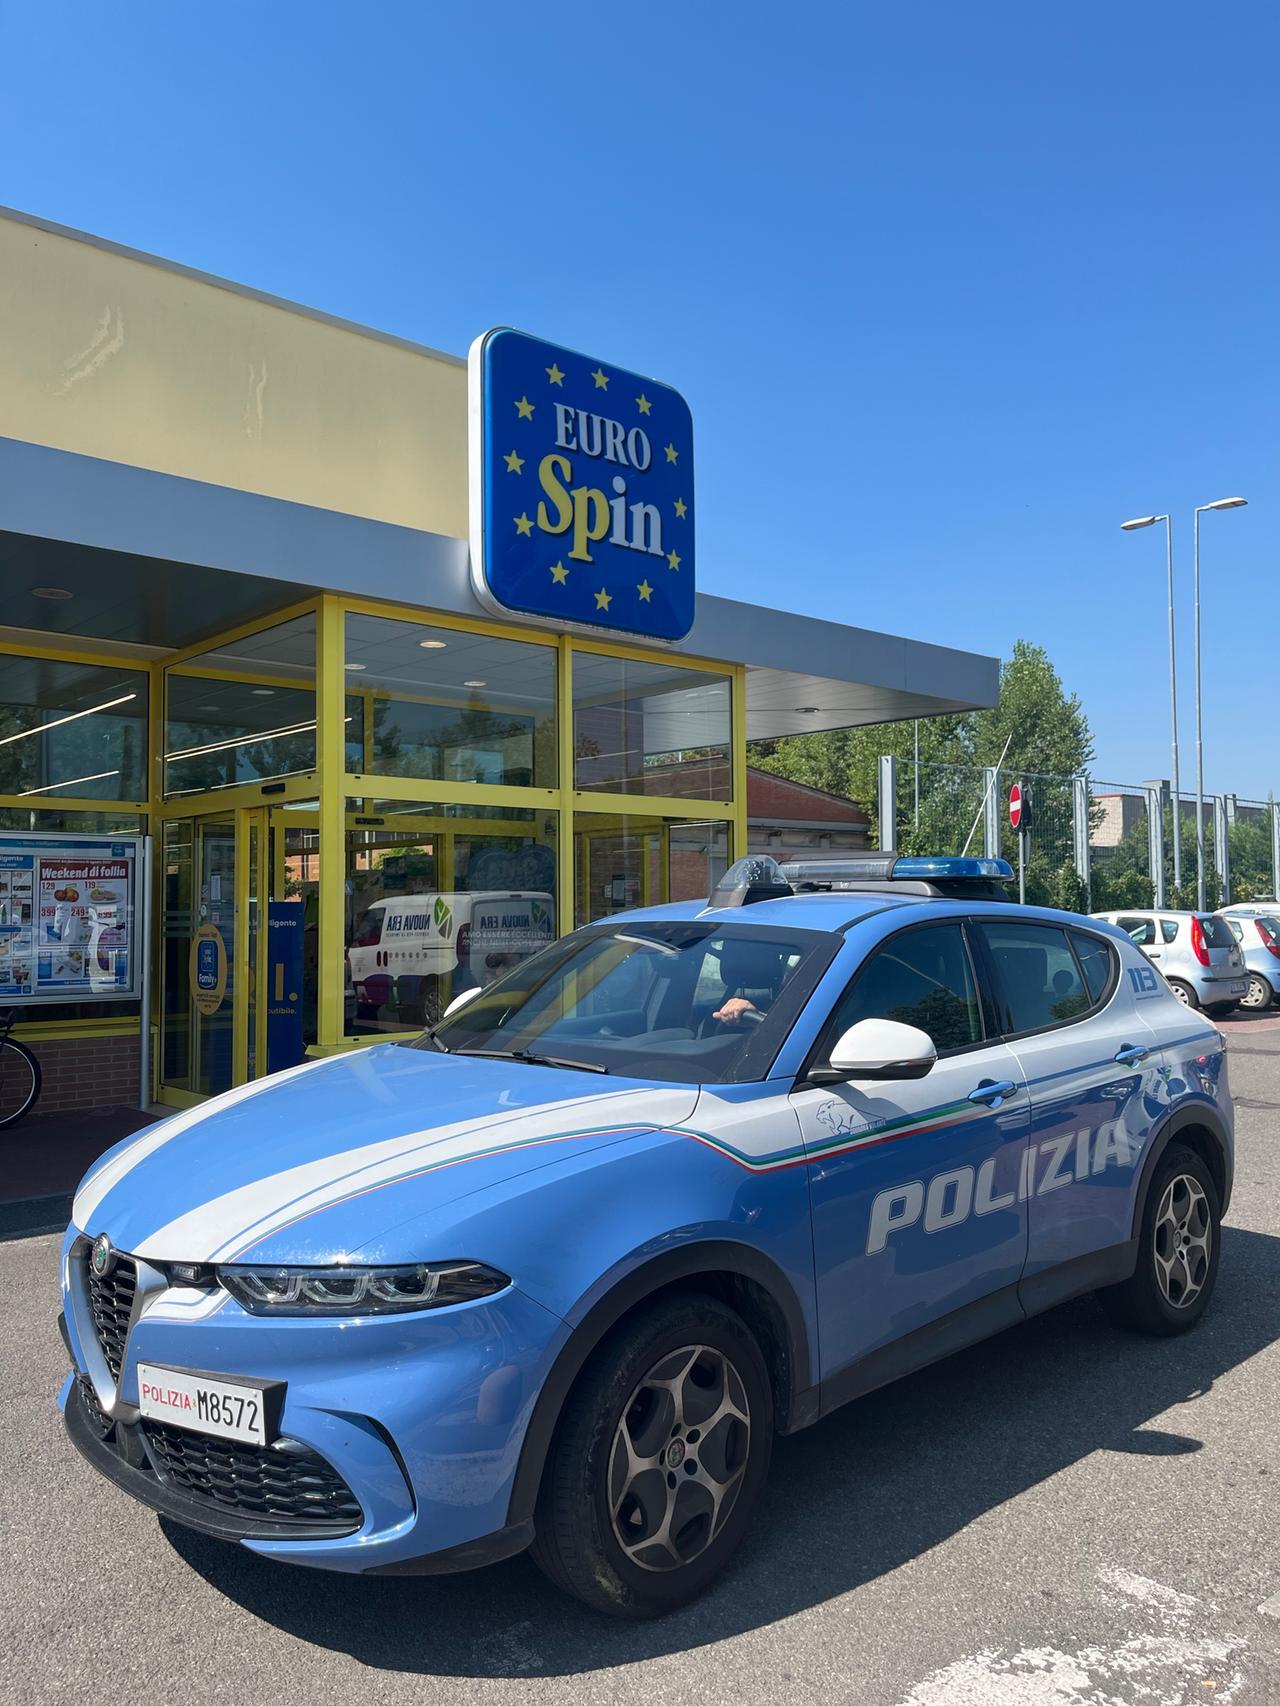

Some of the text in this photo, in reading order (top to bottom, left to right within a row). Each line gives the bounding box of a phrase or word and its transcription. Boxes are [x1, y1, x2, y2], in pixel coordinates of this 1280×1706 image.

[553, 402, 651, 471] EURO
[537, 454, 665, 562] Spin
[41, 866, 126, 879] Weekend di follia
[1127, 967, 1159, 993] 113
[865, 1118, 1132, 1257] POLIZIA
[142, 1383, 259, 1432] POLIZIA M8572
